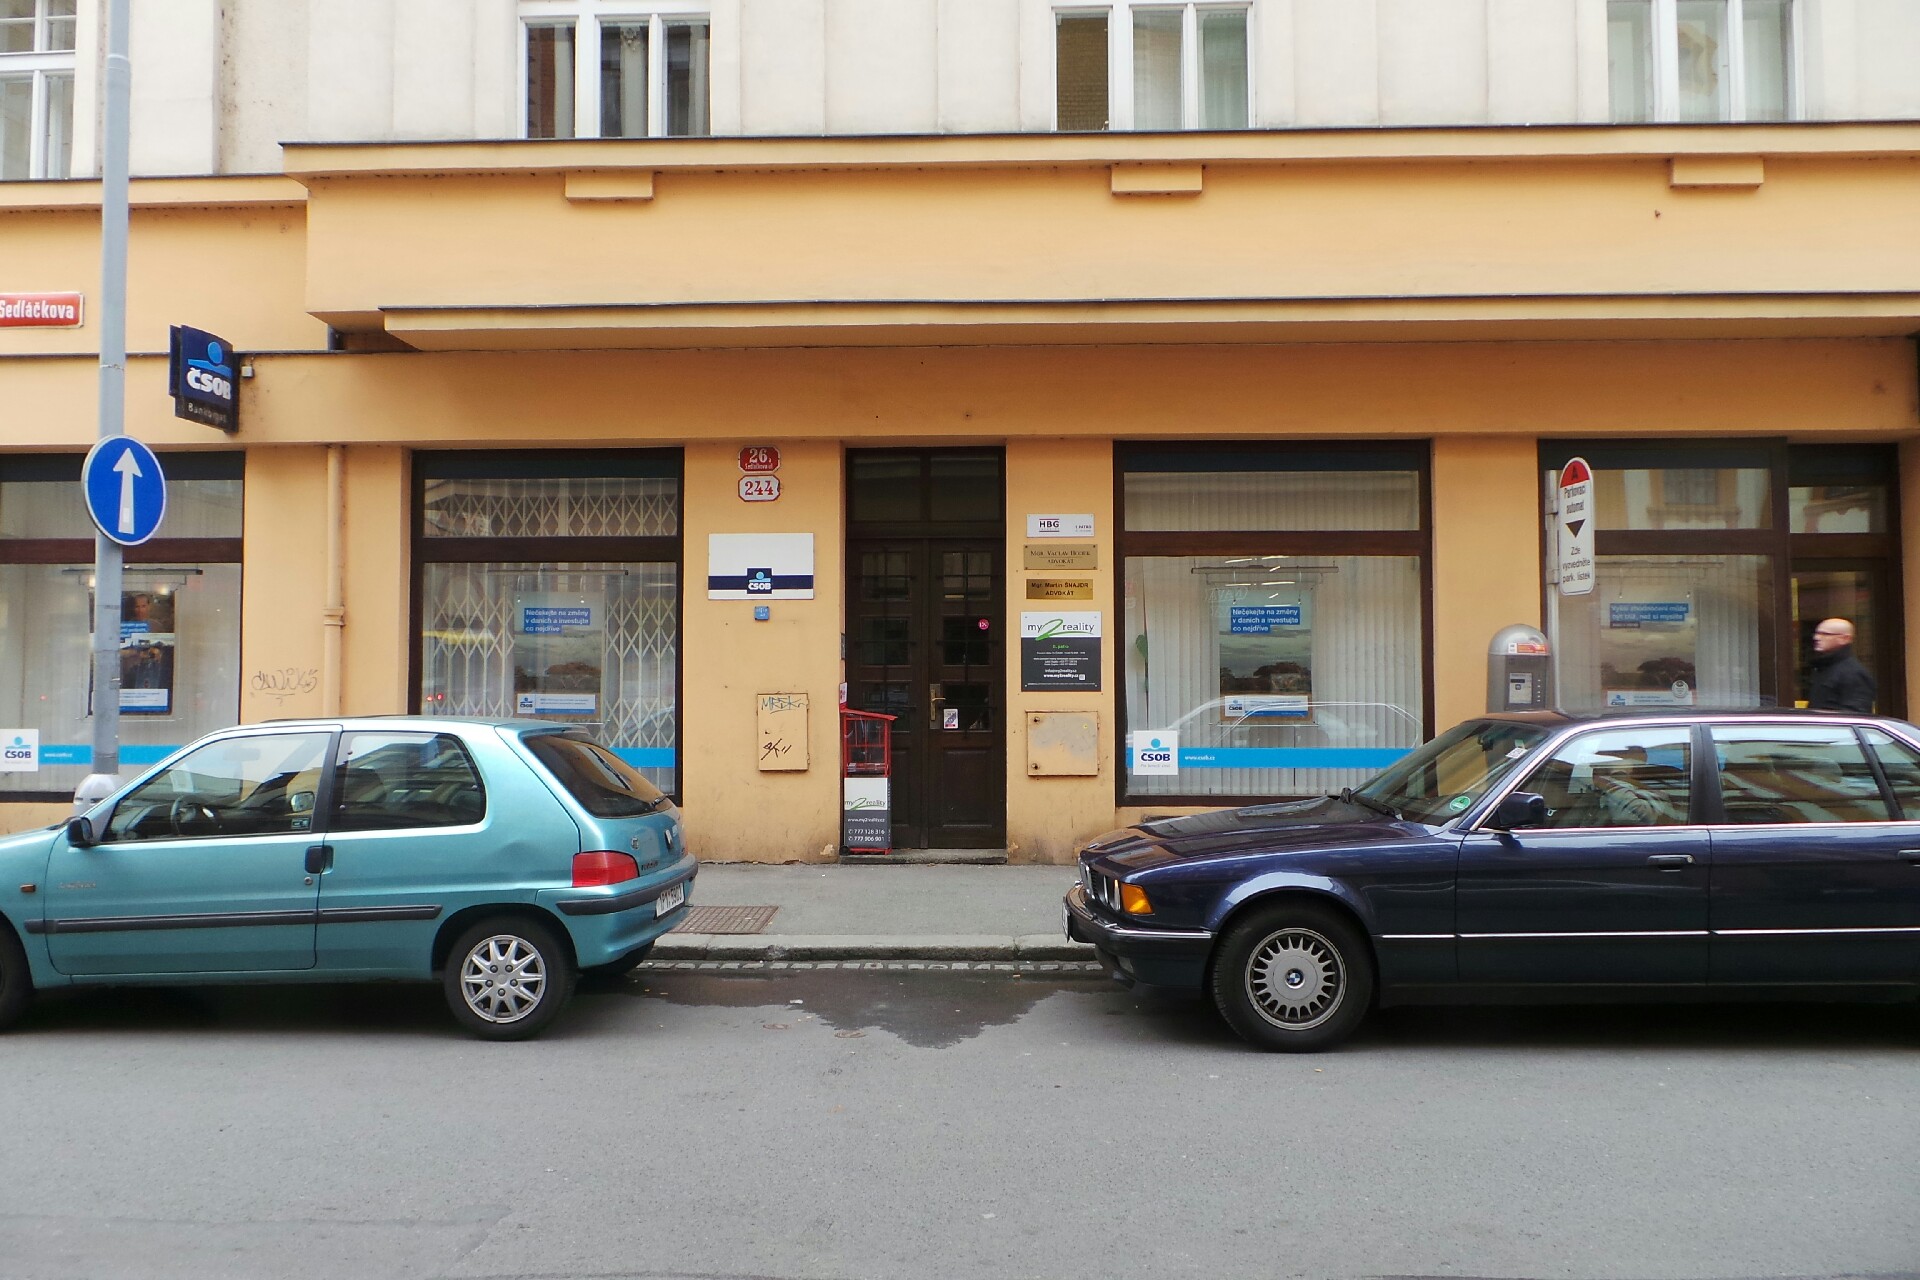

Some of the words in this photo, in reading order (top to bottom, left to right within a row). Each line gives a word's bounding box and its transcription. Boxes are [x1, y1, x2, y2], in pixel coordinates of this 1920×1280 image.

[186, 367, 232, 400] ČSOB
[745, 480, 773, 496] 244
[1566, 500, 1585, 515] automat
[1039, 520, 1060, 528] HBG
[1570, 546, 1581, 556] Zde
[4, 751, 32, 759] ČSOB
[1140, 752, 1171, 762] ČSOB
